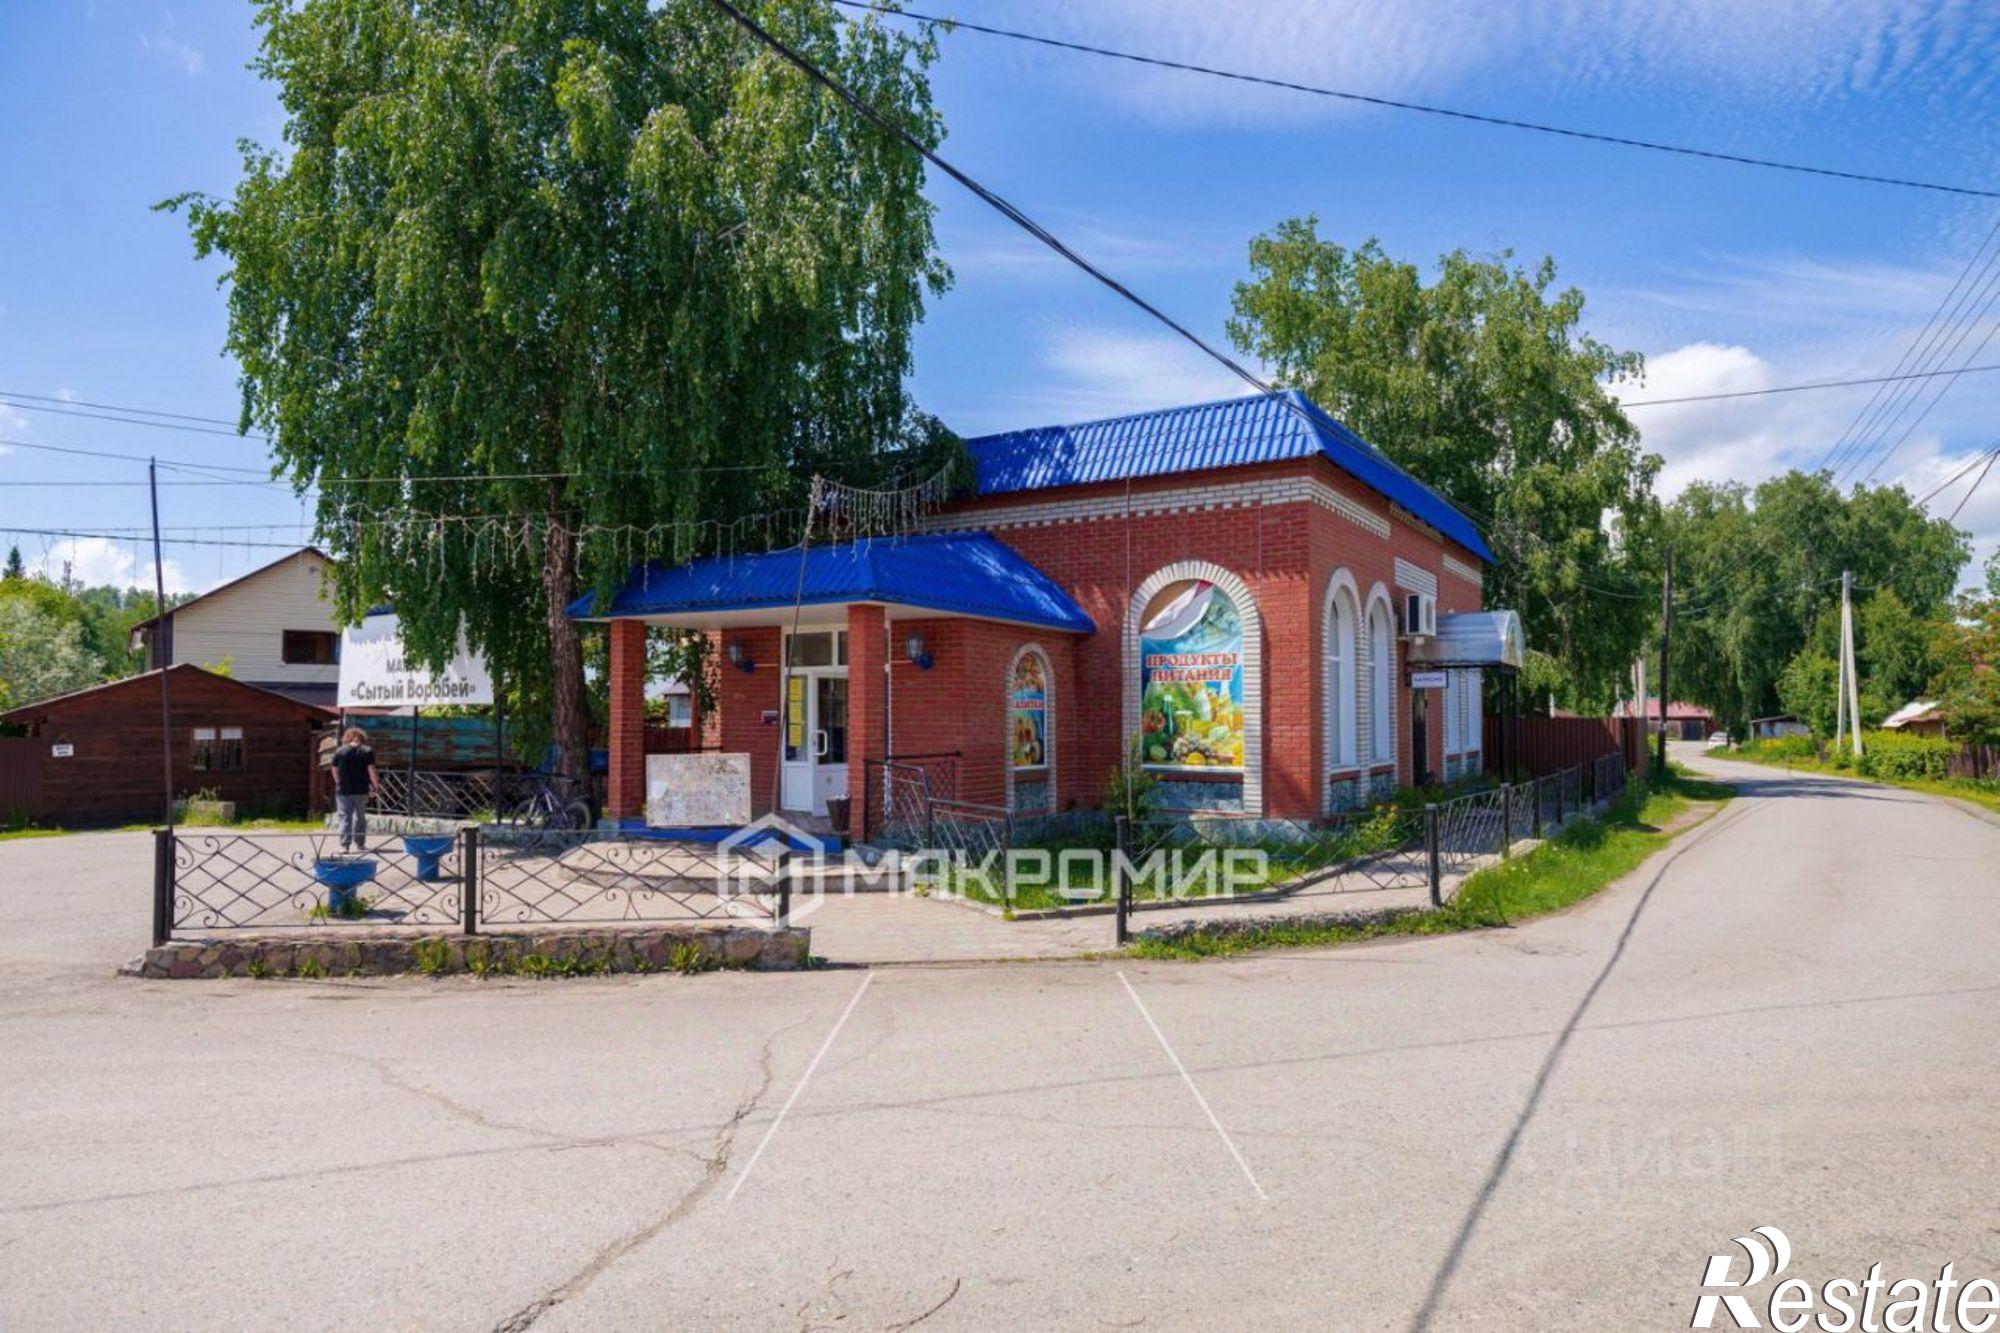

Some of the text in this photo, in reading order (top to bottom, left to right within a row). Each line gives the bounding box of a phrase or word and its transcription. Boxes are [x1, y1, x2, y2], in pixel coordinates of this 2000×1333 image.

[1146, 652, 1238, 667] ПРОДУКТЫ
[1151, 669, 1232, 682] ПИТАНИЯ
[351, 676, 475, 701] «Сытый Воробей»
